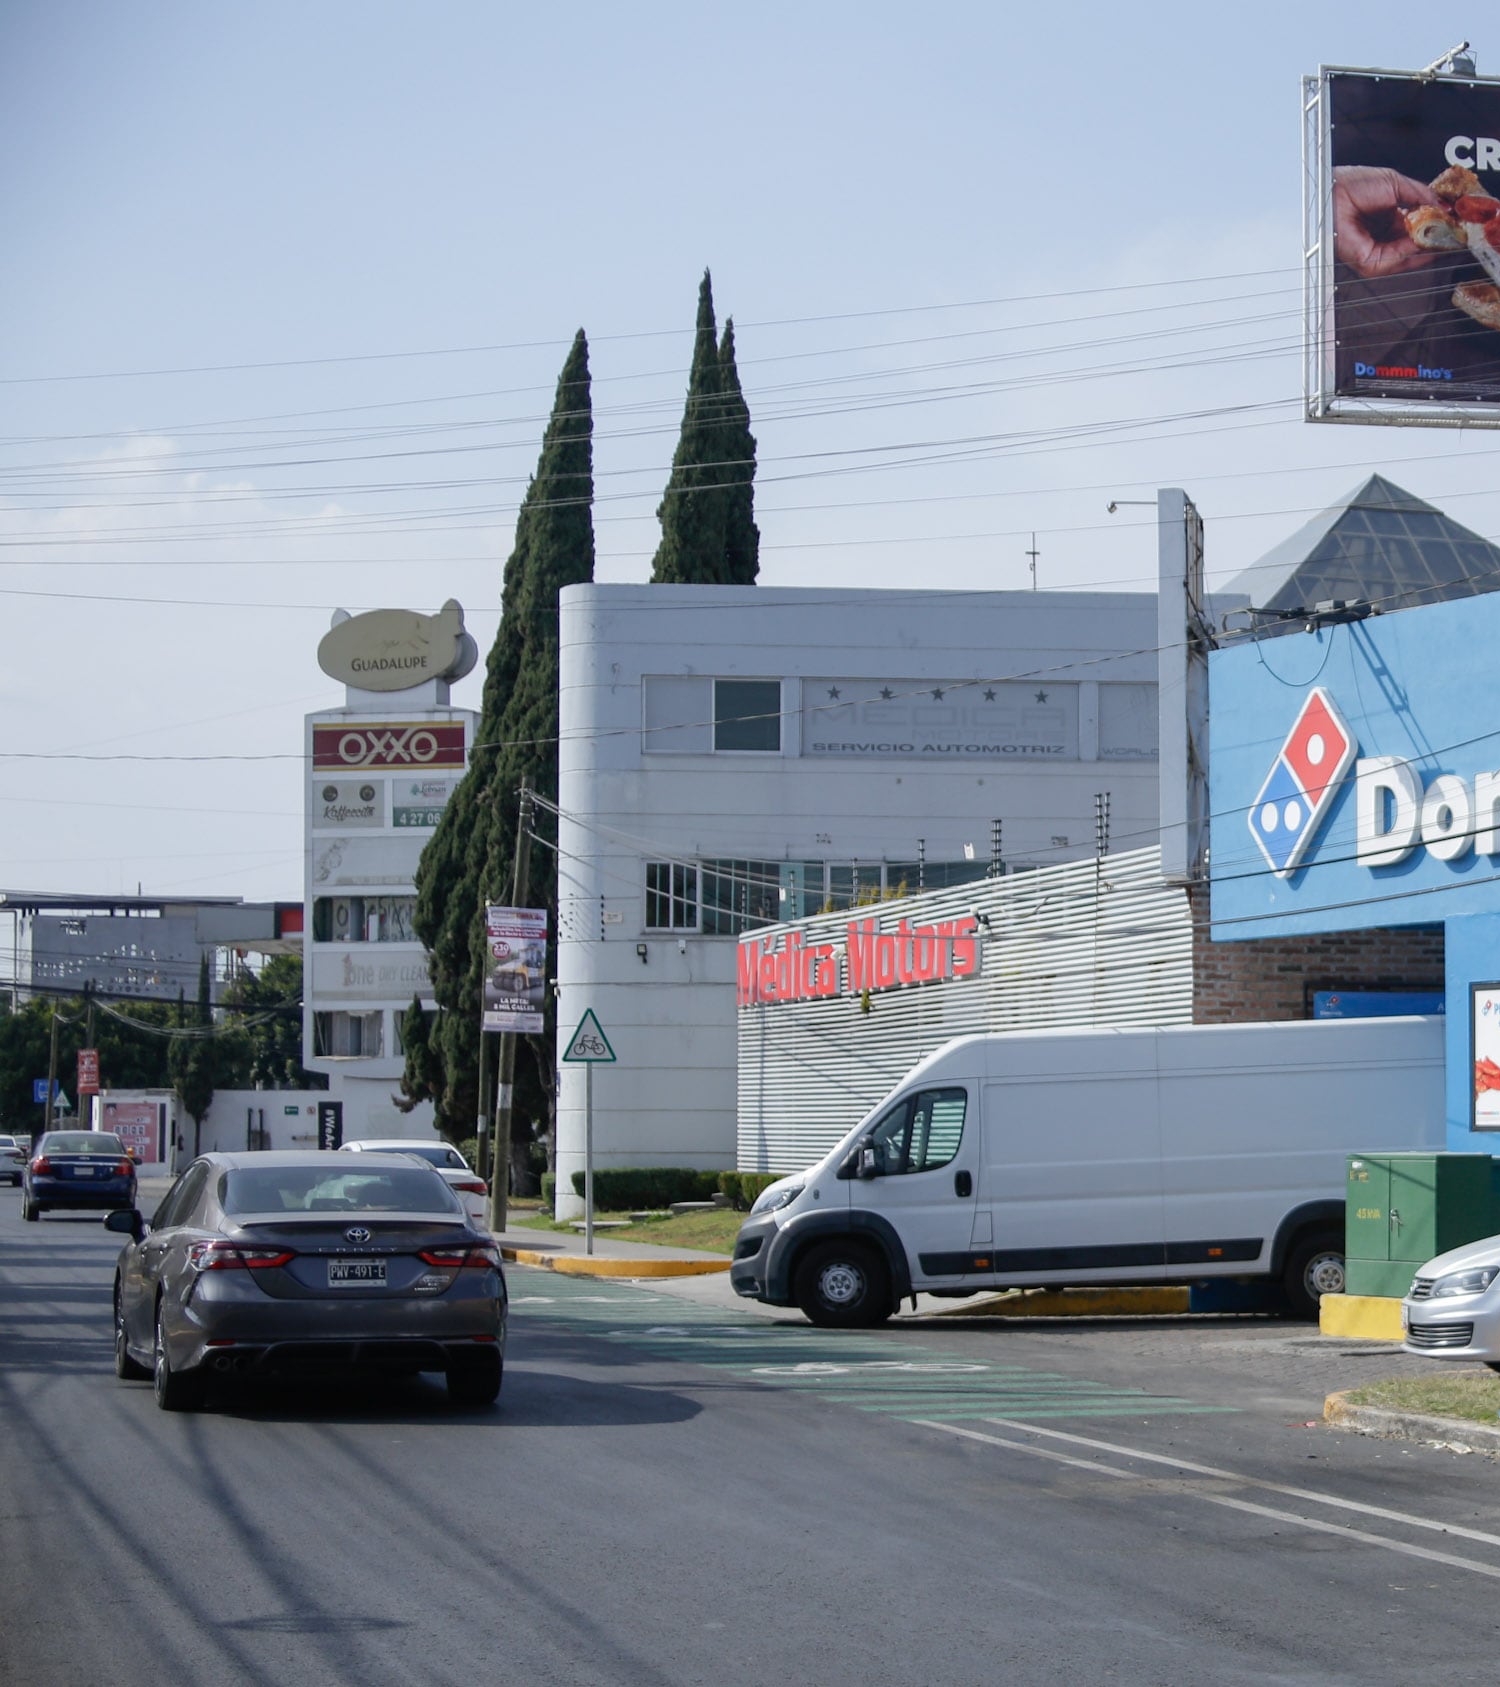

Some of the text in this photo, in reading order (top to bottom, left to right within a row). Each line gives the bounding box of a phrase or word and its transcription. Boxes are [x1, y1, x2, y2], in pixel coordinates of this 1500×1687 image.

[1354, 362, 1453, 380] Dommmino's
[338, 729, 438, 765] OXXO
[812, 743, 1066, 754] SERVICIO AUTOMOTRIZ
[736, 916, 980, 1007] Médica Motors
